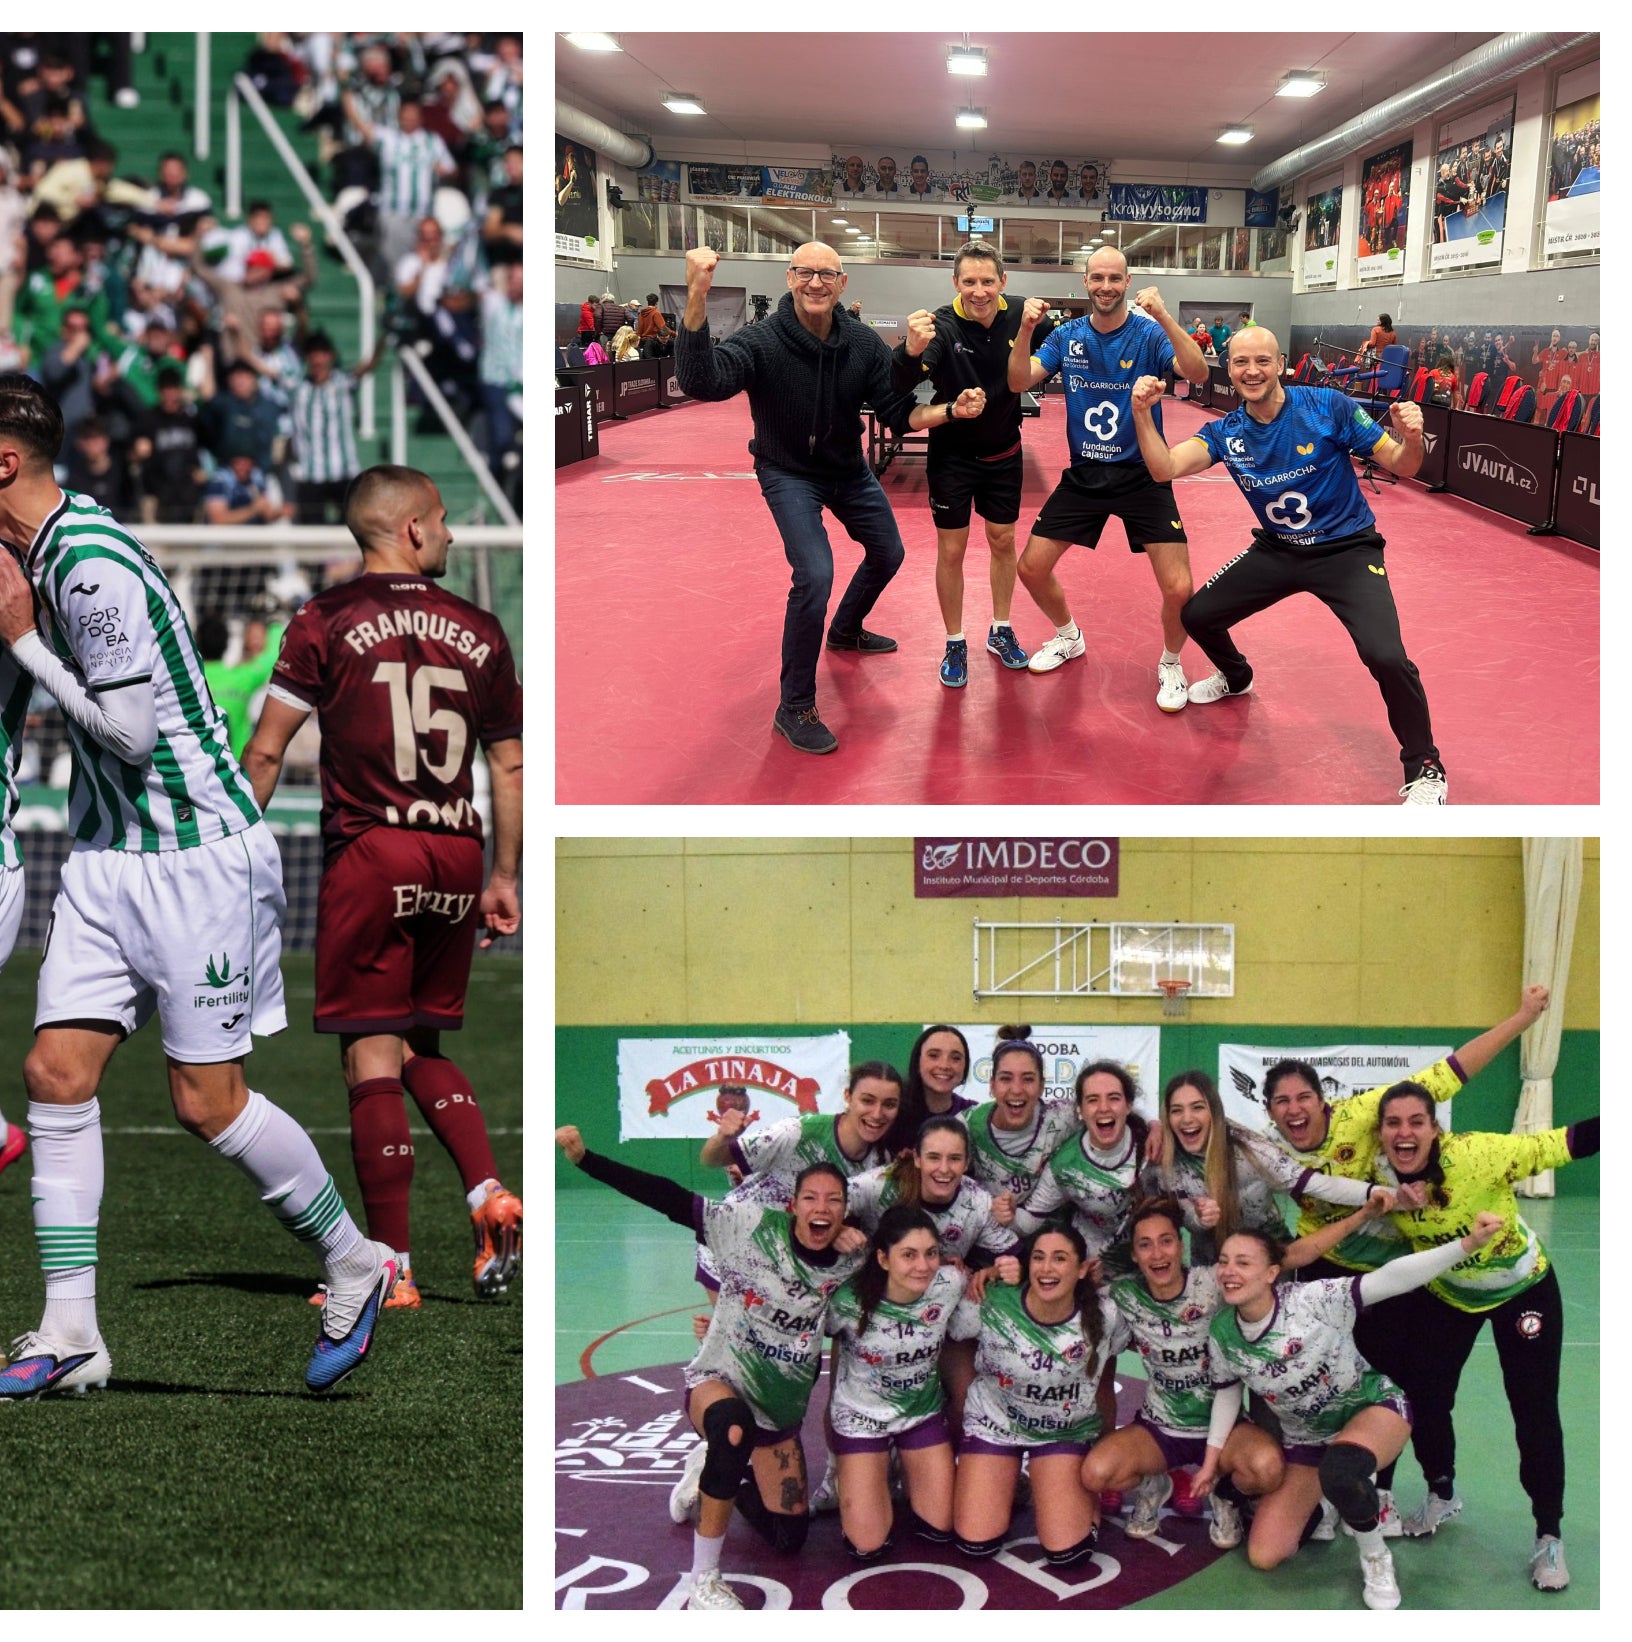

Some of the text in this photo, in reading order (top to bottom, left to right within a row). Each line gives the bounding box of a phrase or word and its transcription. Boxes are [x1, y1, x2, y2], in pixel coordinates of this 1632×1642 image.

[766, 187, 833, 205] ELEKTROKOLA
[1090, 382, 1130, 390] GARROCHA
[1081, 450, 1114, 460] cajasur
[1082, 441, 1122, 453] fundación
[1252, 464, 1317, 488] LA GARROCHA
[344, 608, 492, 669] FRANQUESA
[371, 661, 469, 785] 15
[967, 839, 1111, 870] IMDECO
[923, 874, 1110, 886] Instituto Municipal de Deportes Córdoba
[193, 990, 250, 1009] iFertility
[672, 1045, 723, 1055] ACEITUNAS
[1352, 1057, 1366, 1067] DEL
[1367, 1055, 1410, 1067] AUTOMÓVIL
[664, 1060, 798, 1098] LA TINAJA
[1011, 1176, 1031, 1194] 99
[1032, 1349, 1054, 1373] 34
[1161, 1342, 1210, 1363] RAH
[1153, 1371, 1211, 1393] Sepisu
[1026, 1382, 1081, 1402] RAHI
